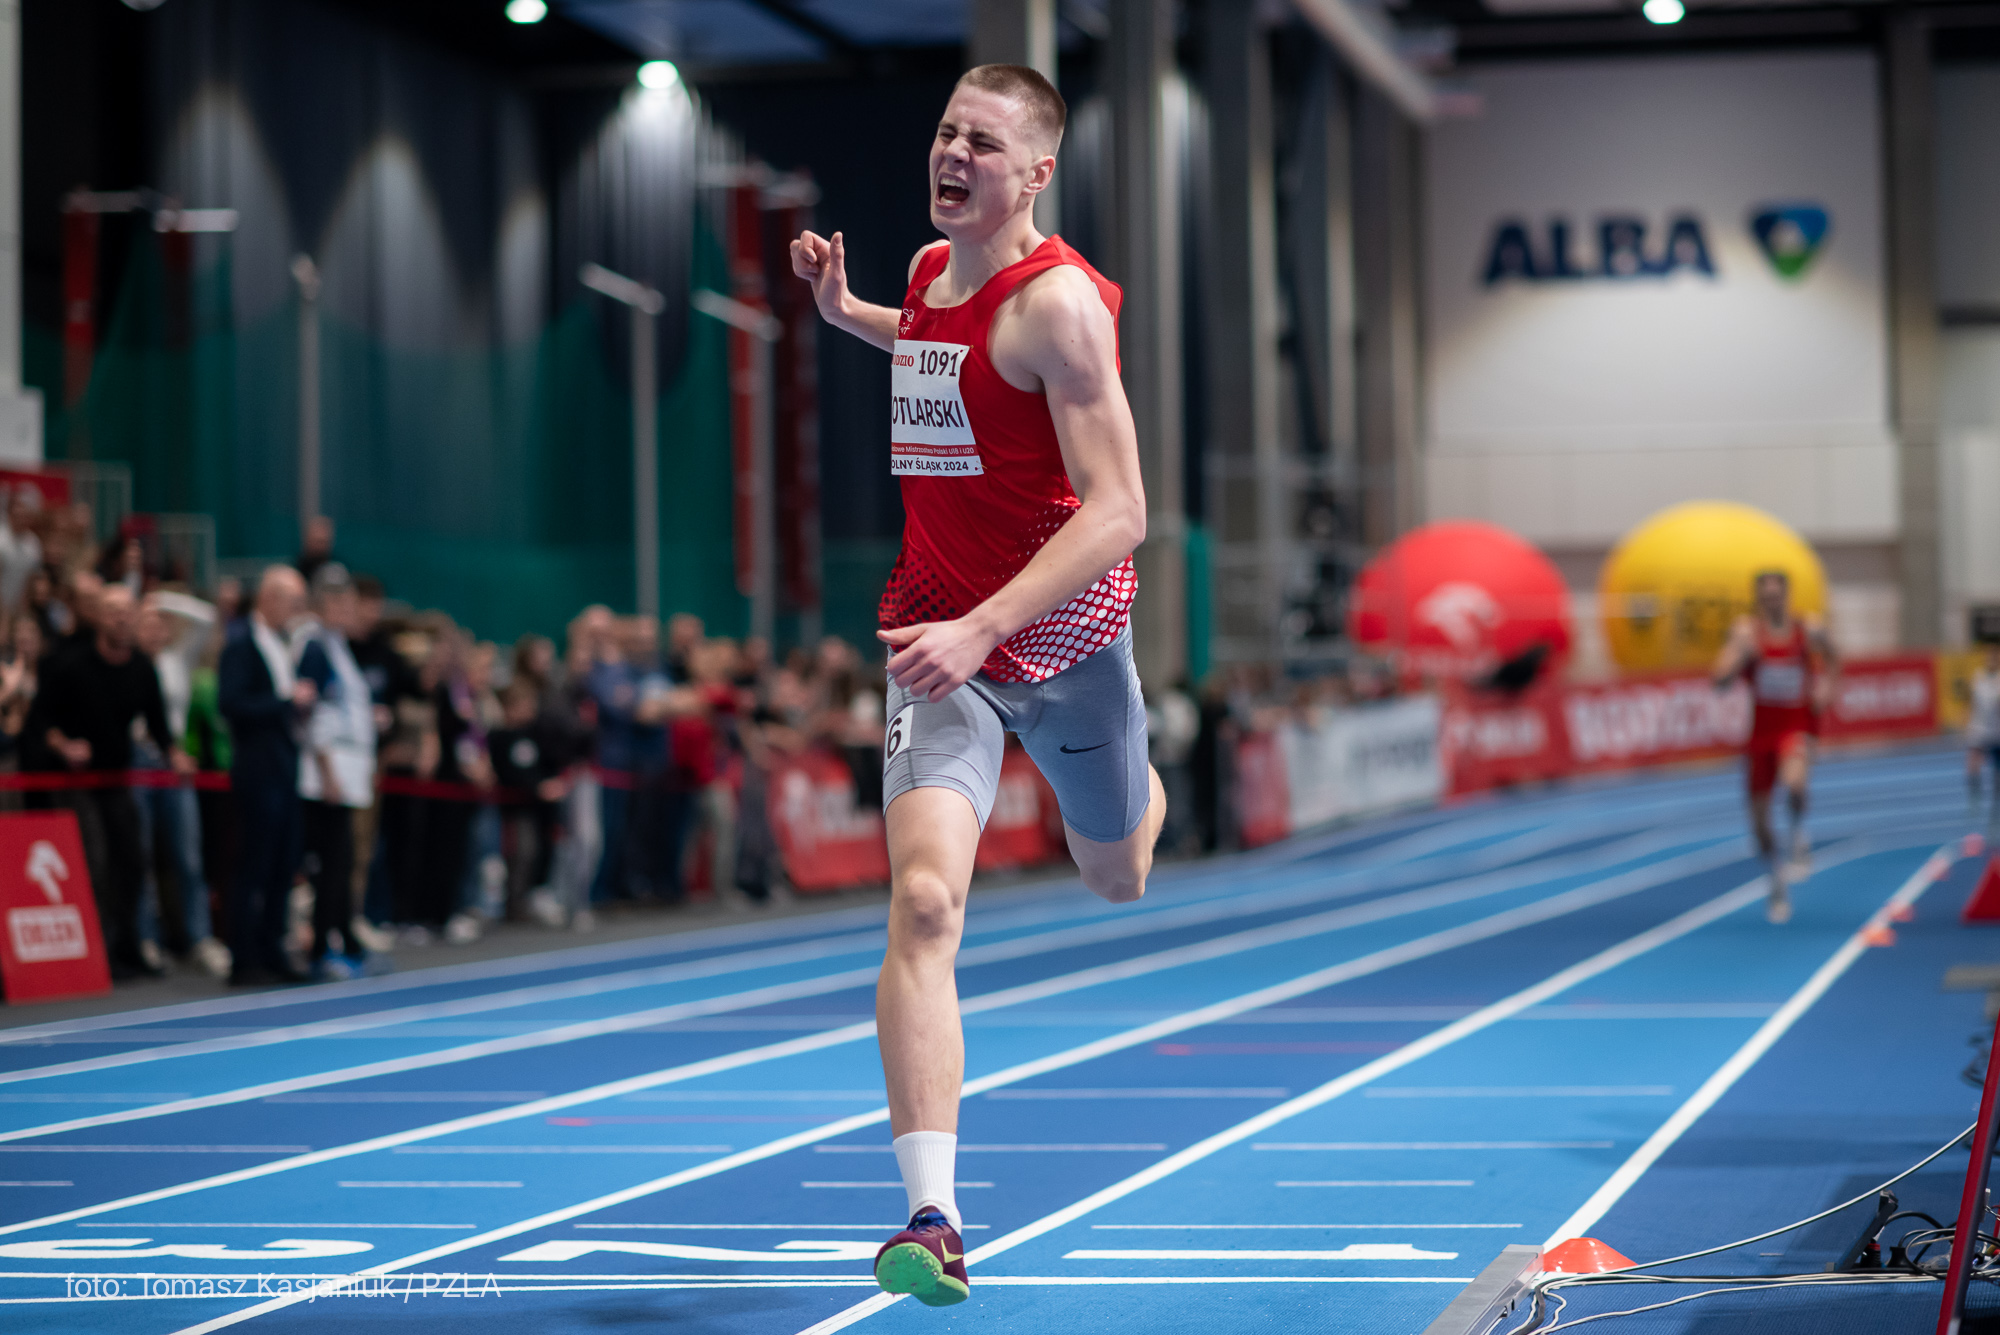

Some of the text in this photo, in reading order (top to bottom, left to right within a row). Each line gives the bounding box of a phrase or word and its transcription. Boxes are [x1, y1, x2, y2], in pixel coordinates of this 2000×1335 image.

[1482, 215, 1720, 284] ALBA
[918, 349, 959, 377] 1091
[892, 396, 964, 428] OTLARSKI
[892, 457, 969, 473] OLNY ŚLĄSK 2024
[887, 716, 902, 760] 6
